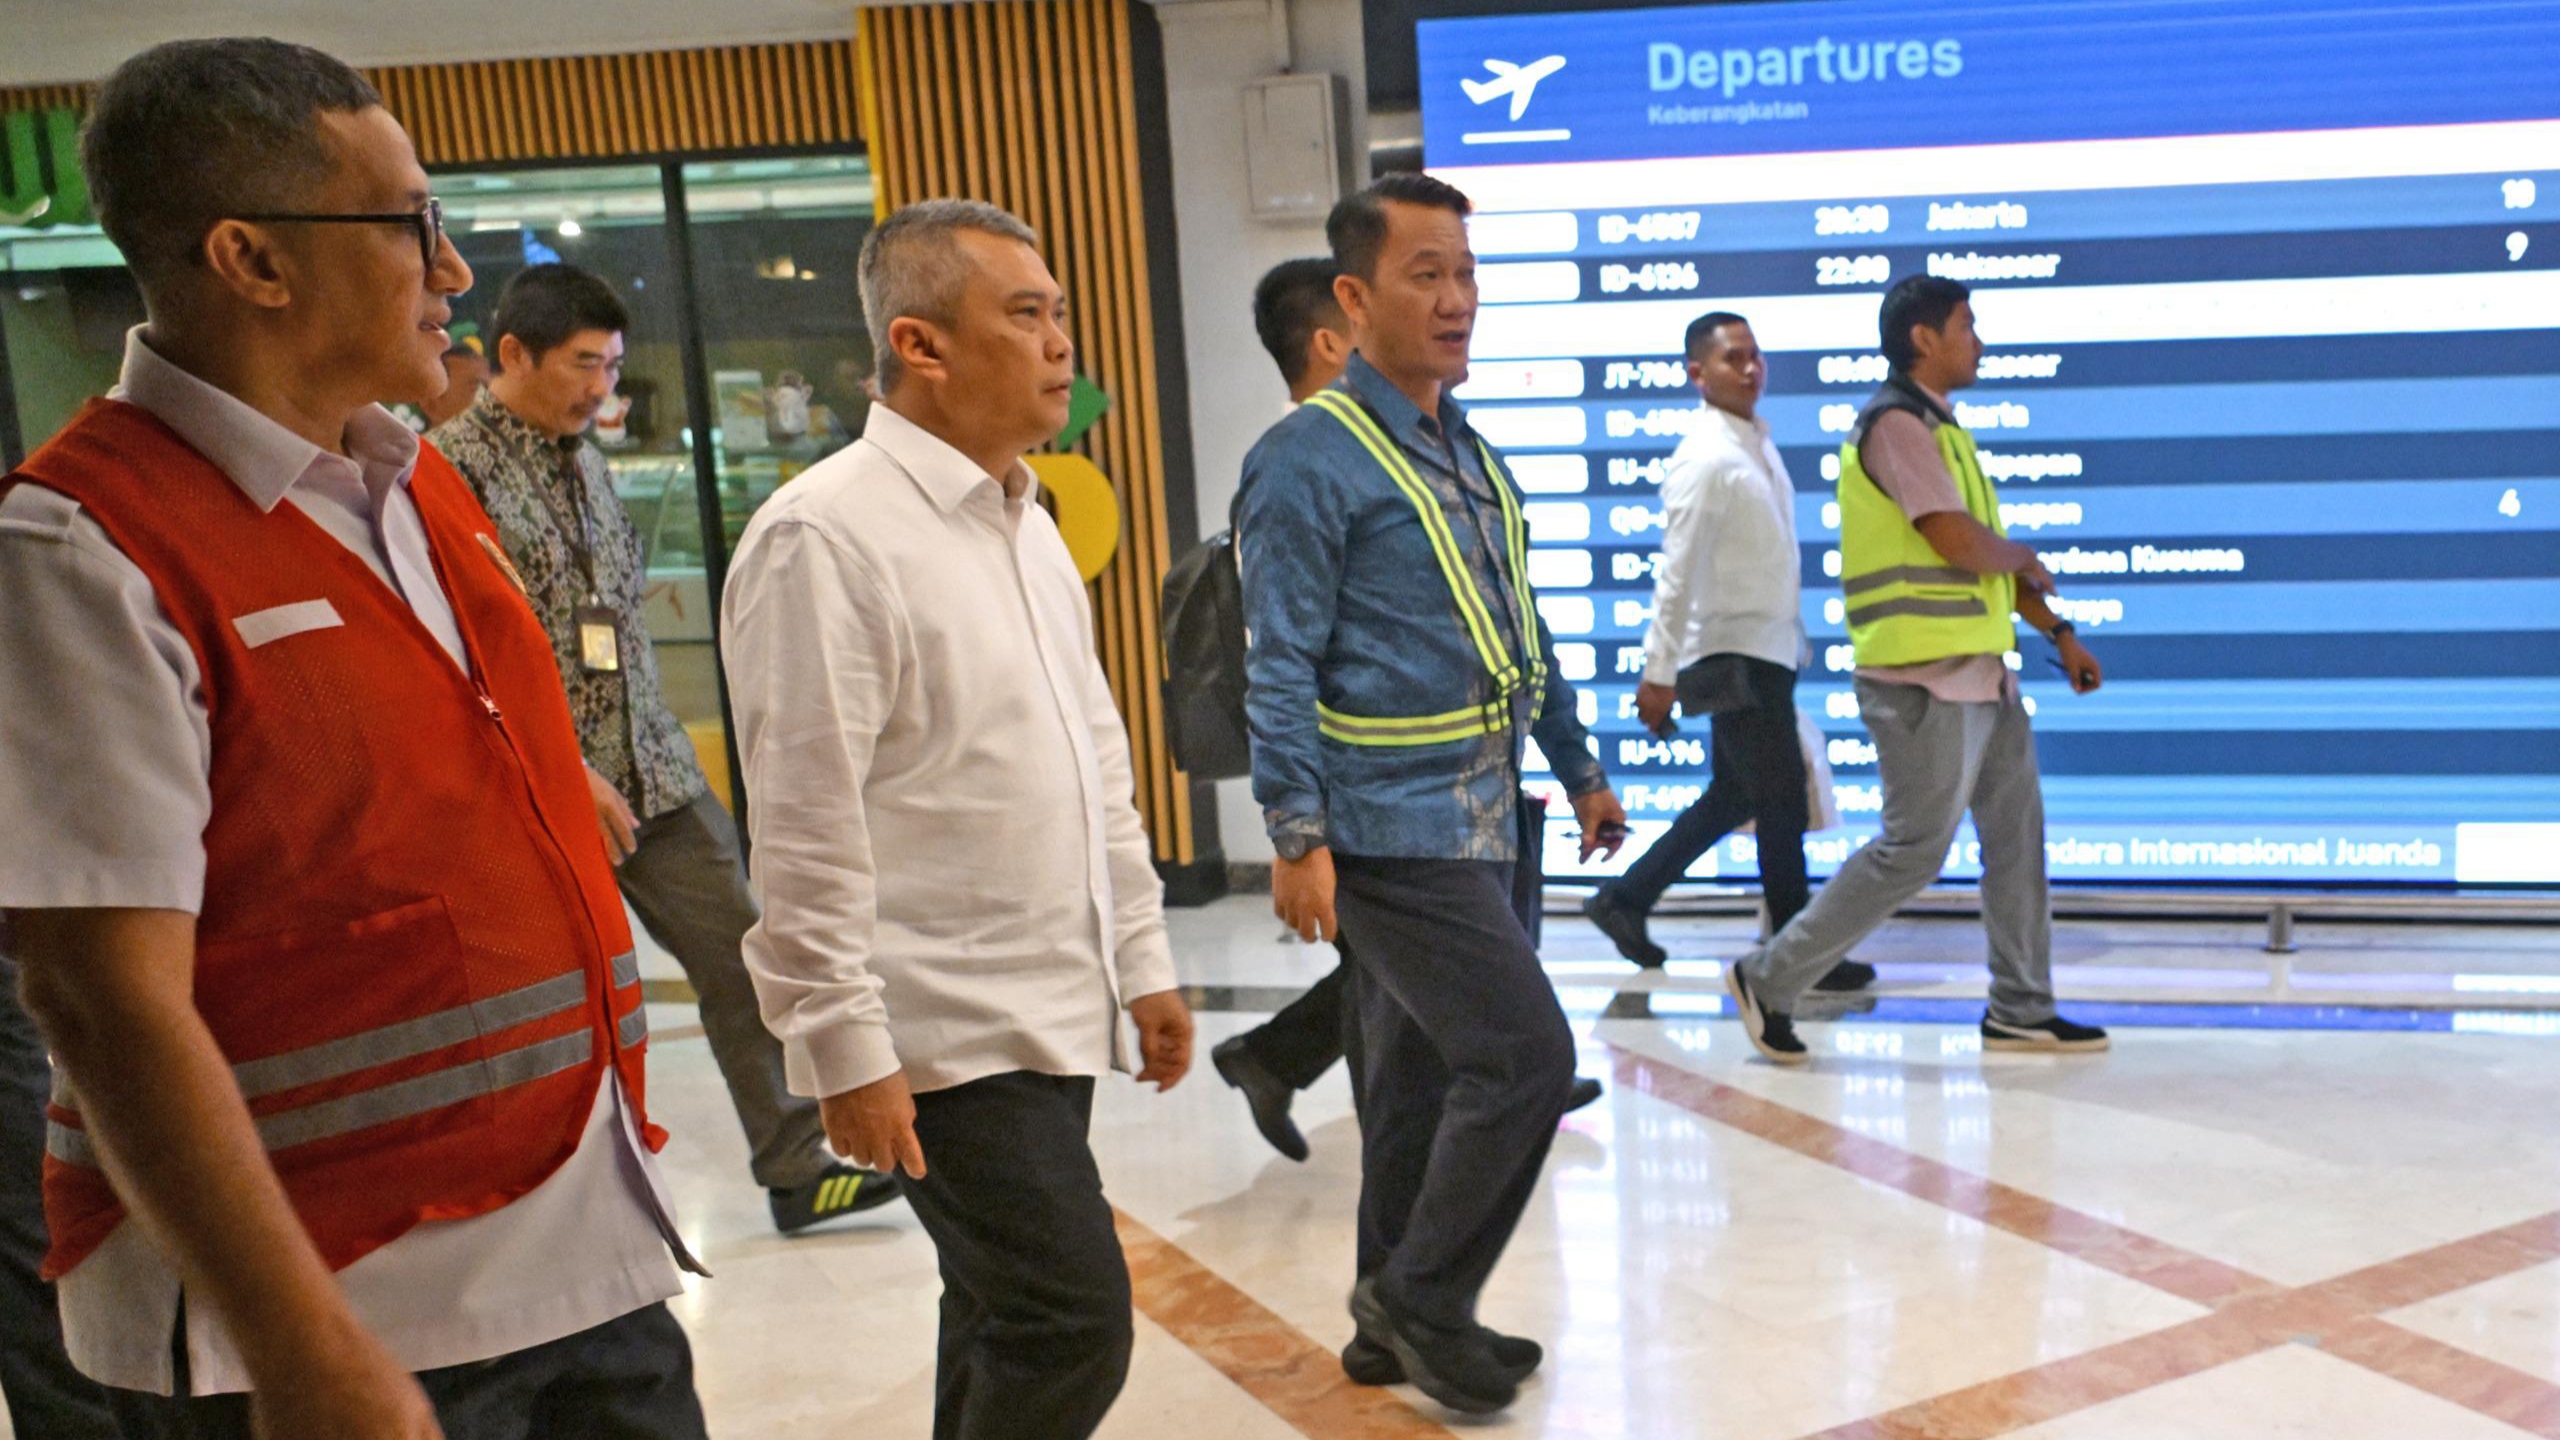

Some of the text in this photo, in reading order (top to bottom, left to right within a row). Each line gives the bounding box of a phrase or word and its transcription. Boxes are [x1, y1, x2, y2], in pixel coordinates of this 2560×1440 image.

[1648, 36, 1963, 98] Departures
[1648, 101, 1809, 126] Keberangkatan
[1926, 201, 2028, 231] Jakarta
[2501, 178, 2536, 209] 10
[2505, 231, 2529, 262] 9
[2498, 488, 2521, 517] 4
[2129, 837, 2329, 866] Internasional
[2333, 838, 2442, 866] Juanda
